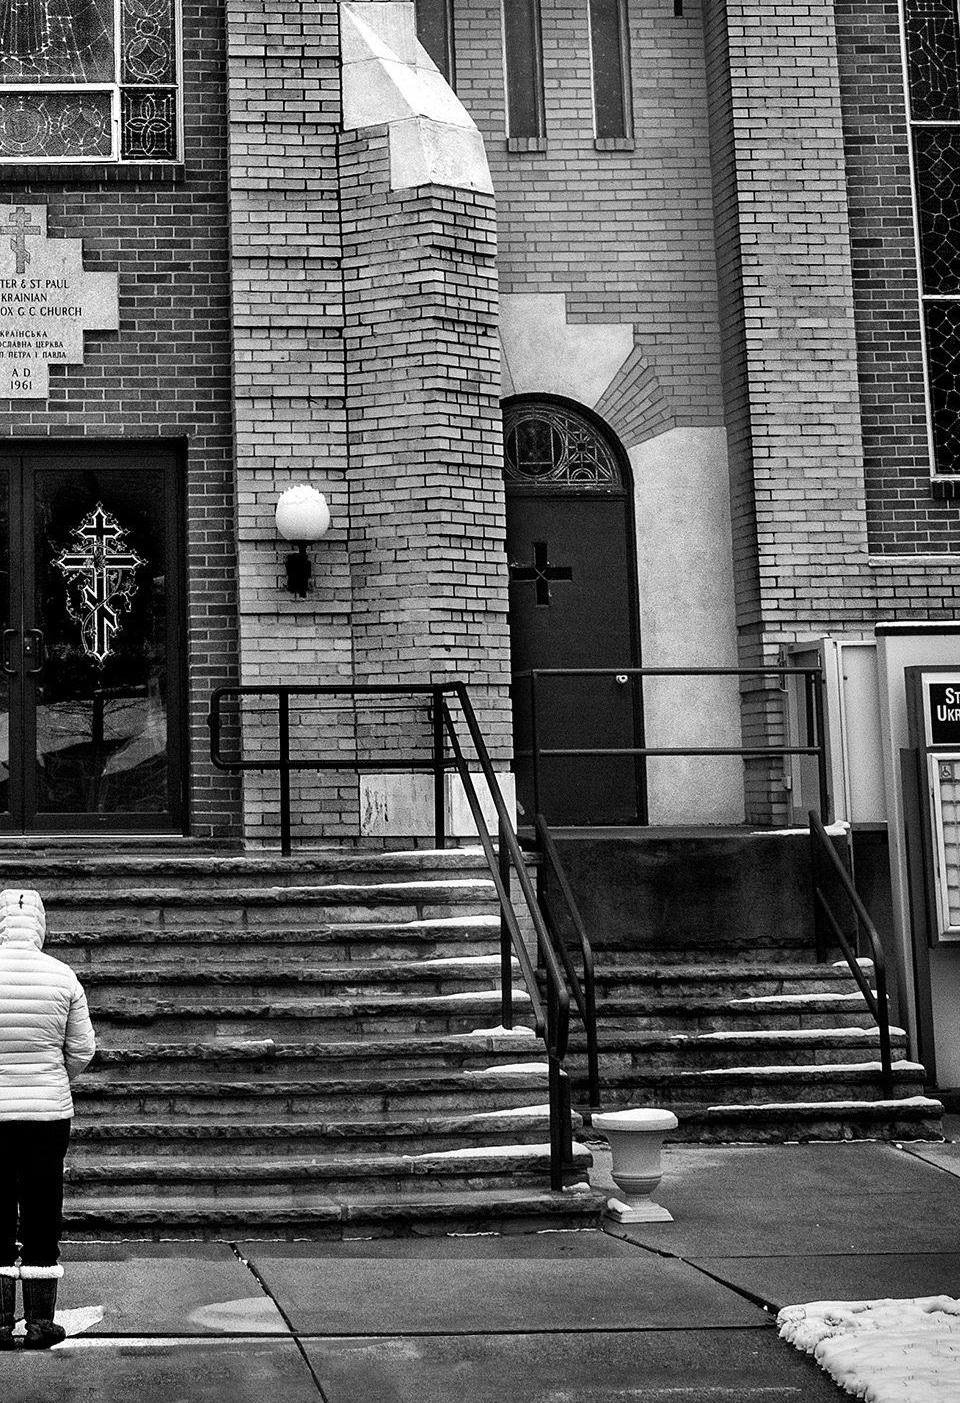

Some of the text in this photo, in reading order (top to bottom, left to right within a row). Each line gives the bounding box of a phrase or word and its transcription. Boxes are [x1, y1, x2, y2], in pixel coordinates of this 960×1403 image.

[20, 279, 27, 289] &
[45, 279, 70, 289] PAUL
[40, 306, 82, 316] CHURCH
[35, 340, 64, 349] ЦЕРКВА
[8, 351, 31, 359] ПЕТРА
[42, 351, 67, 359] ПАВЛА
[10, 380, 32, 390] 1961
